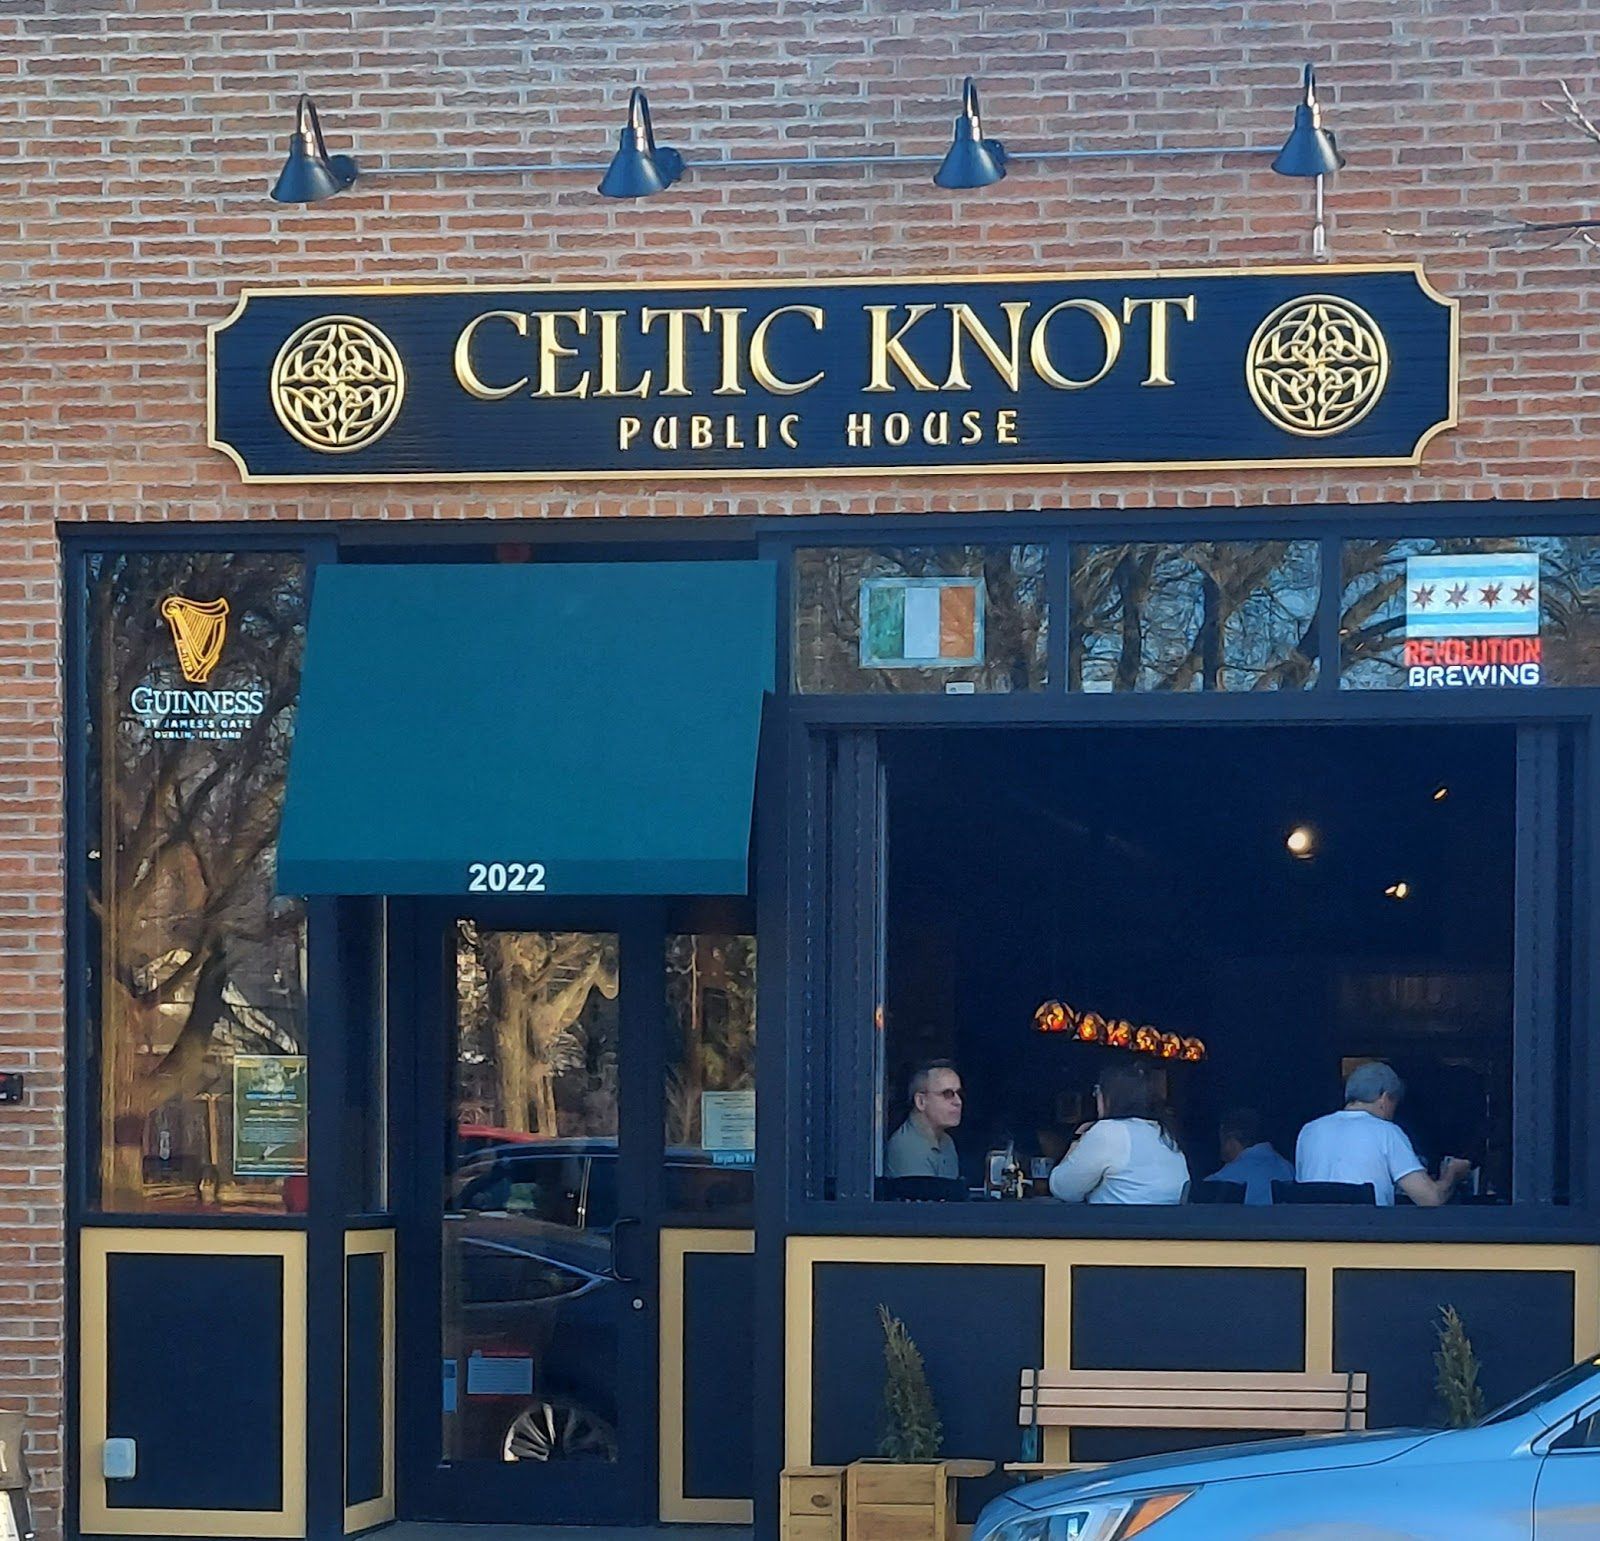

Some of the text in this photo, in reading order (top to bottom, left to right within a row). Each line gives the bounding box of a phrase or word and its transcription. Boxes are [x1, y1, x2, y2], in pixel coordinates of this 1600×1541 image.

[453, 294, 1196, 401] CELTIC KNOT
[618, 408, 1020, 451] PUBLIC HOUSE
[1404, 637, 1542, 666] REVOLUTION
[1408, 663, 1541, 688] BREWING
[131, 686, 264, 715] GUINNESS
[220, 718, 252, 729] GATE
[468, 862, 546, 892] 2022
